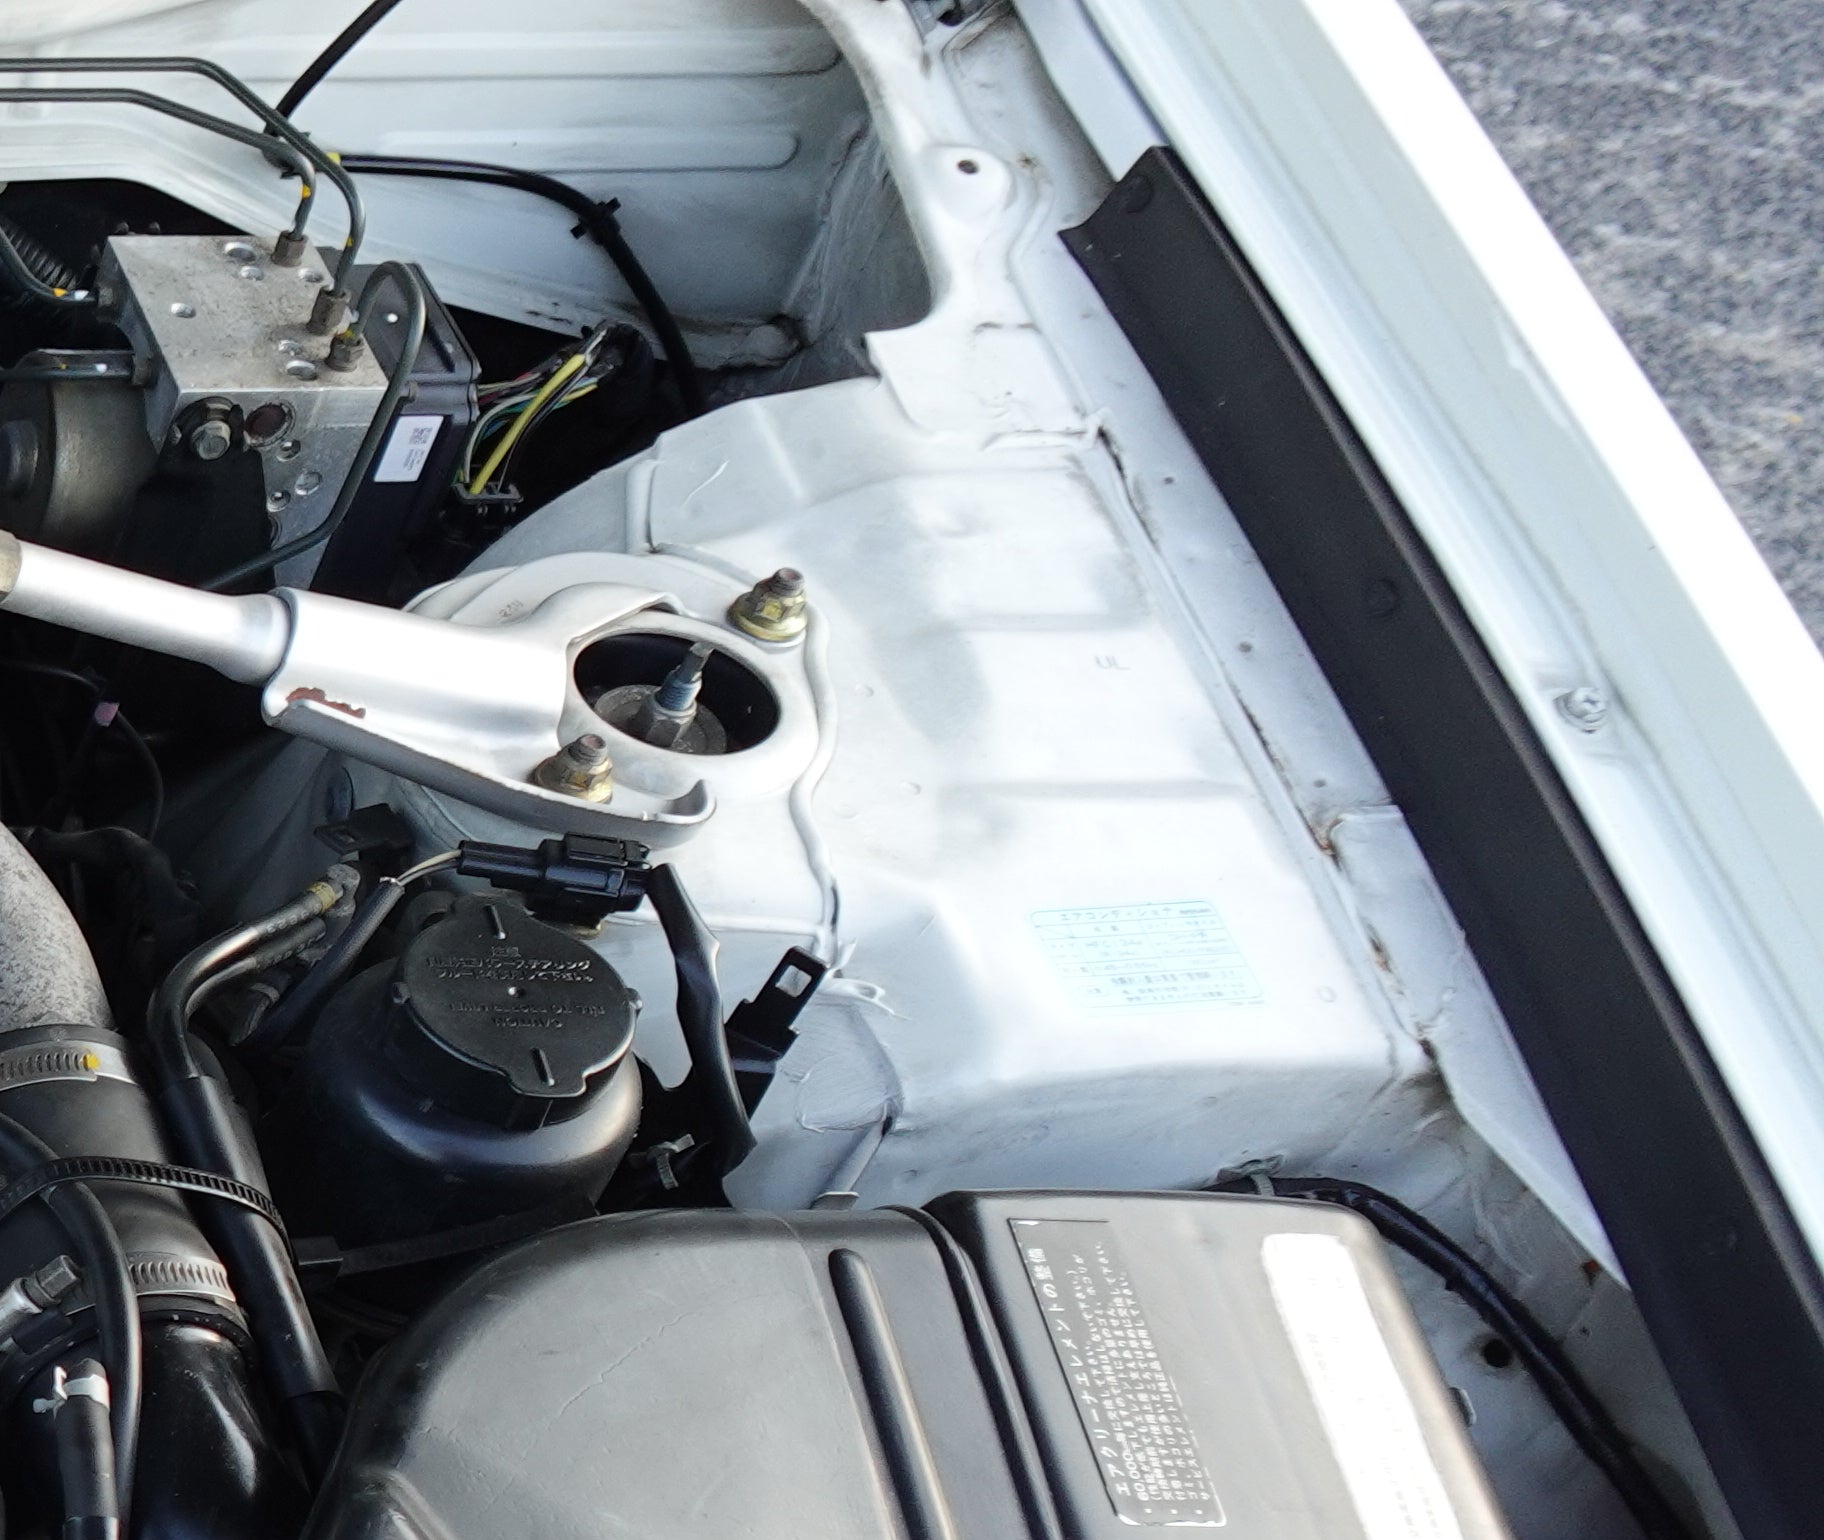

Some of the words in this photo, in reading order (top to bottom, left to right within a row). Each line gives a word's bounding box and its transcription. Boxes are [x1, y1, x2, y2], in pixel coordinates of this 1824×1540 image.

[1027, 1247, 1132, 1496] エアクリーナエレメントの整備
